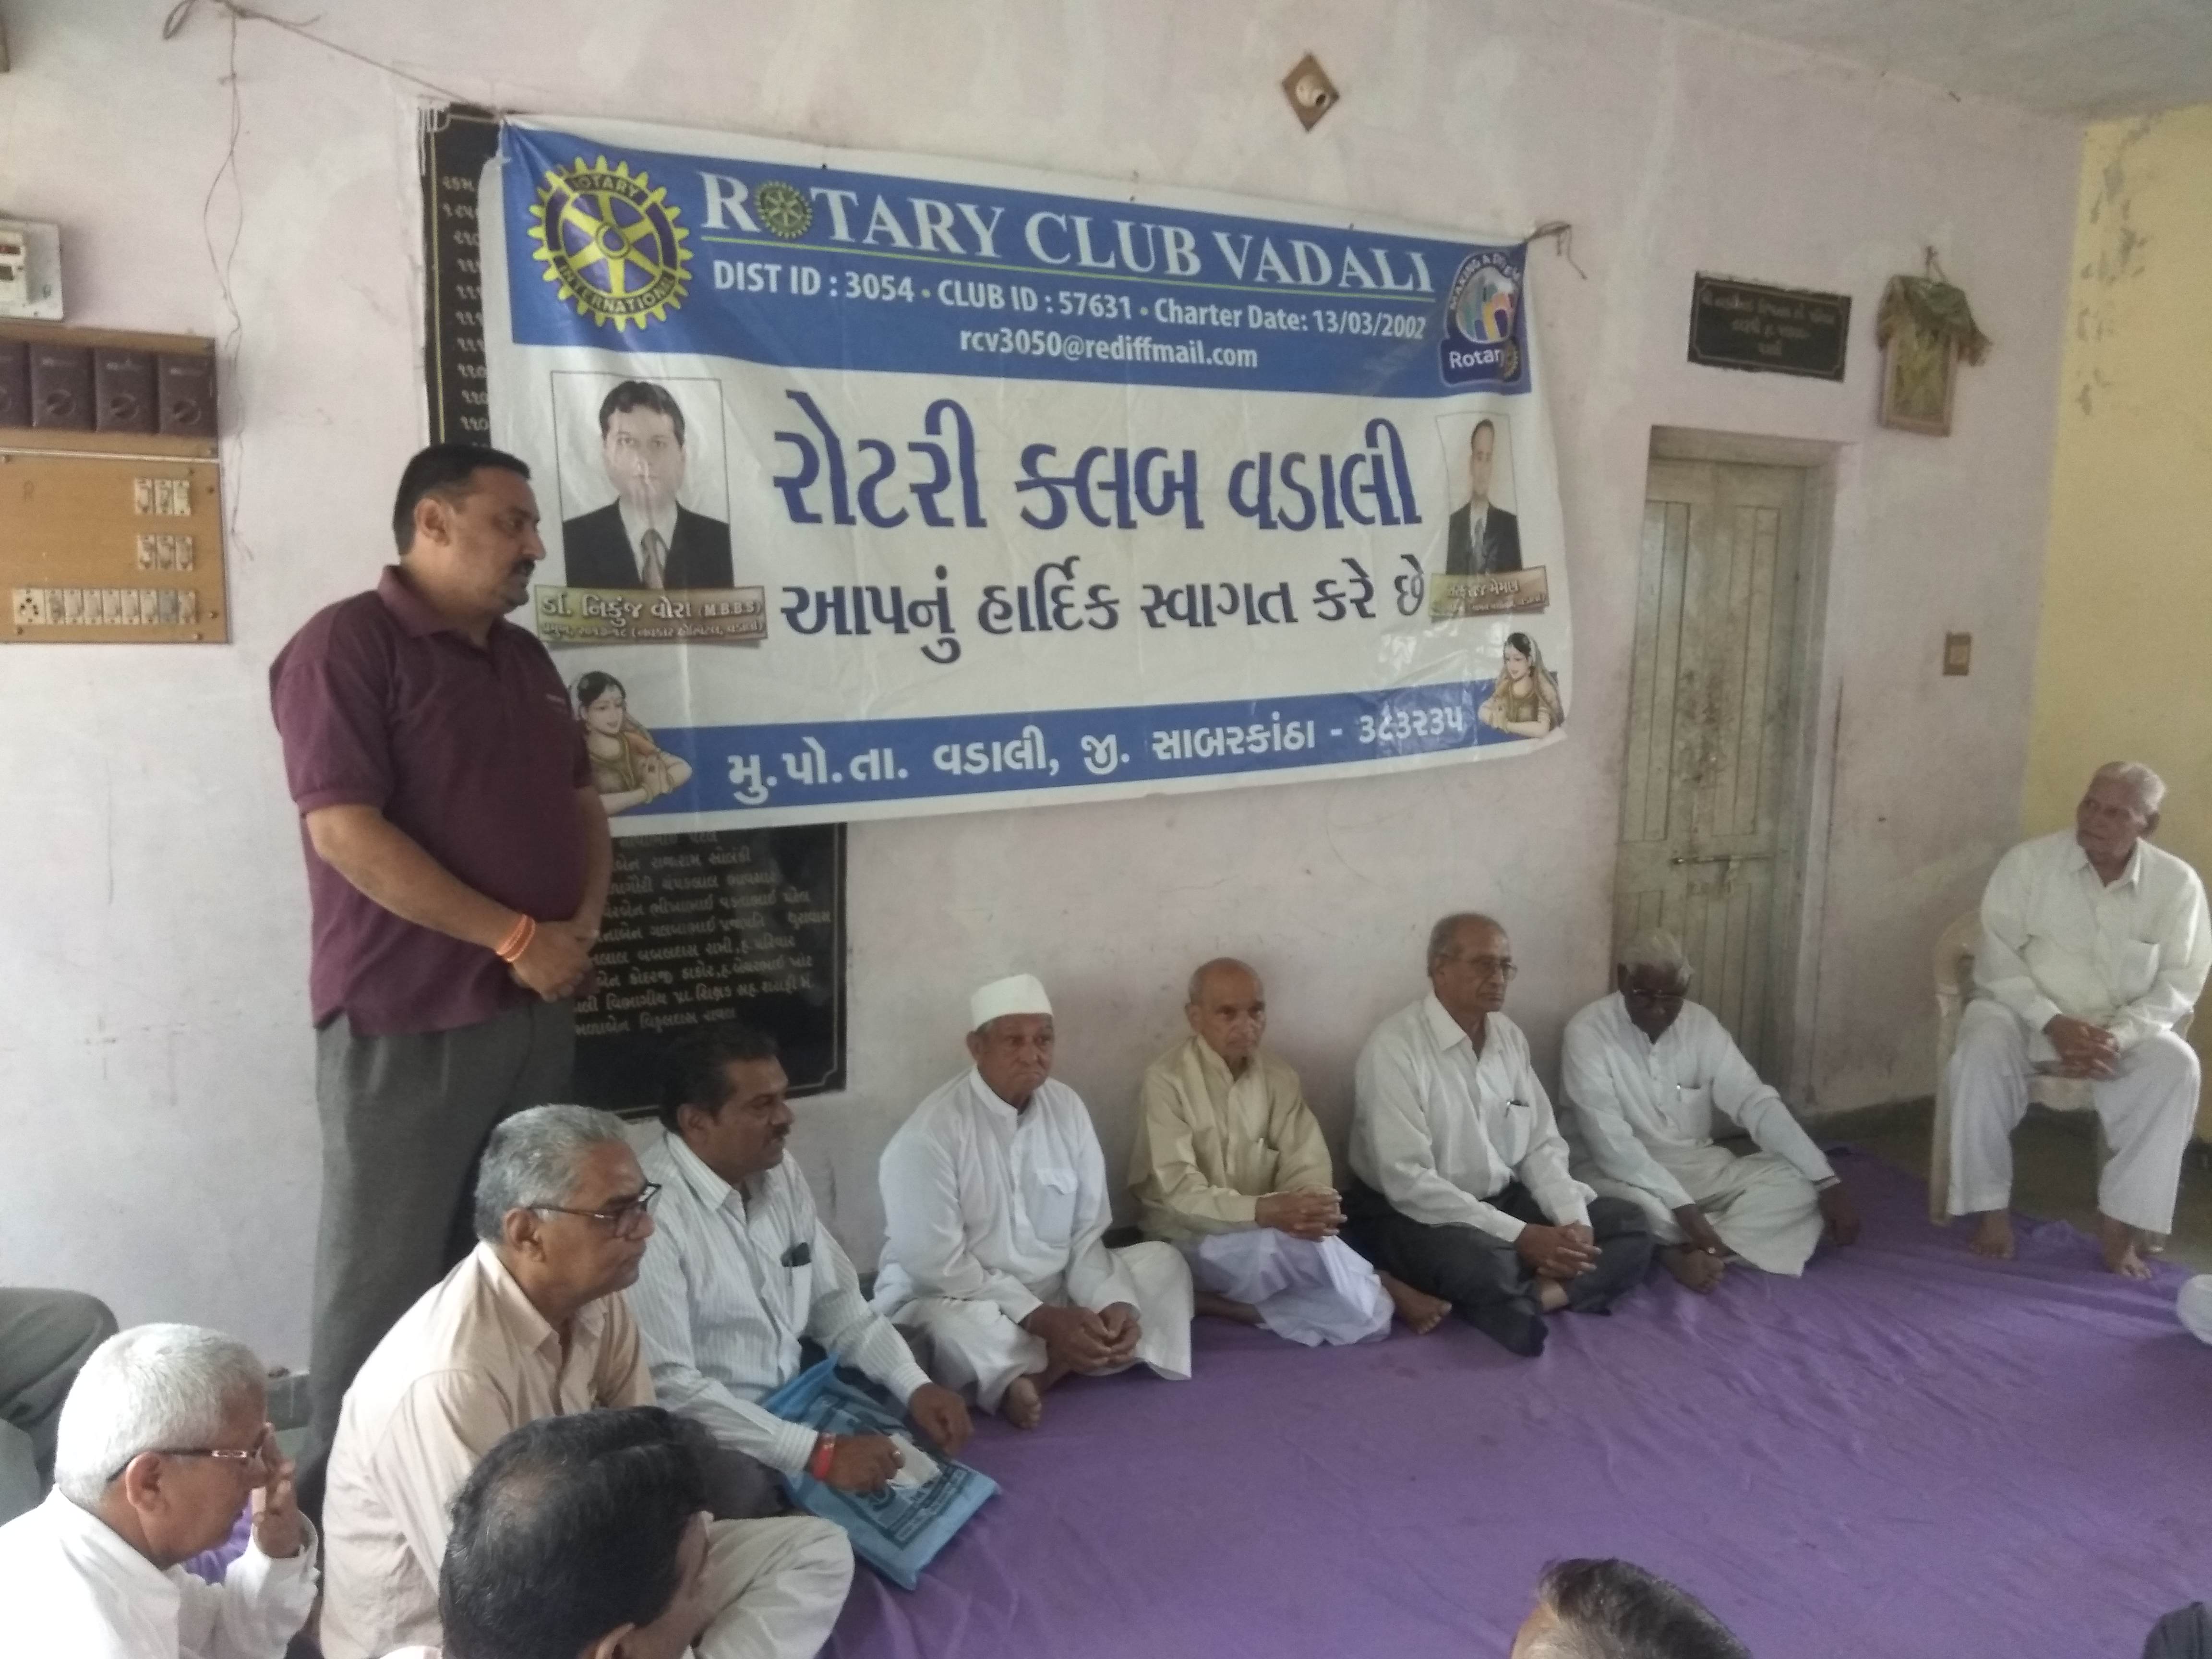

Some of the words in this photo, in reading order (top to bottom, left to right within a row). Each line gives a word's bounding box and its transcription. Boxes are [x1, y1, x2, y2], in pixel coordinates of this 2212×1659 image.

[1025, 211, 1202, 277] CLUB
[1213, 232, 1434, 292] VADALI
[713, 260, 781, 291] DIST
[791, 267, 821, 296] ID
[845, 271, 915, 303] 3054
[938, 279, 1005, 310] CLUB
[1011, 287, 1038, 313] ID
[1060, 291, 1131, 320] 57631
[1155, 301, 1242, 330] Charter
[1248, 305, 1308, 331] Date:
[1313, 310, 1426, 340] 13/03/2002
[961, 328, 1257, 368] rcv3050@rediffmail.com
[773, 389, 987, 528] રોટરી
[1228, 418, 1422, 531] વડાલી
[781, 565, 961, 664] આપનું
[978, 555, 1120, 635] હાર્દિક
[1141, 582, 1298, 628] સ્વાગત
[1313, 557, 1376, 621] કરે
[1395, 553, 1424, 616] છે
[933, 724, 1059, 776] વડાલી,
[1082, 733, 1130, 775] જી.
[1152, 711, 1315, 760] સાબરકાંઠા
